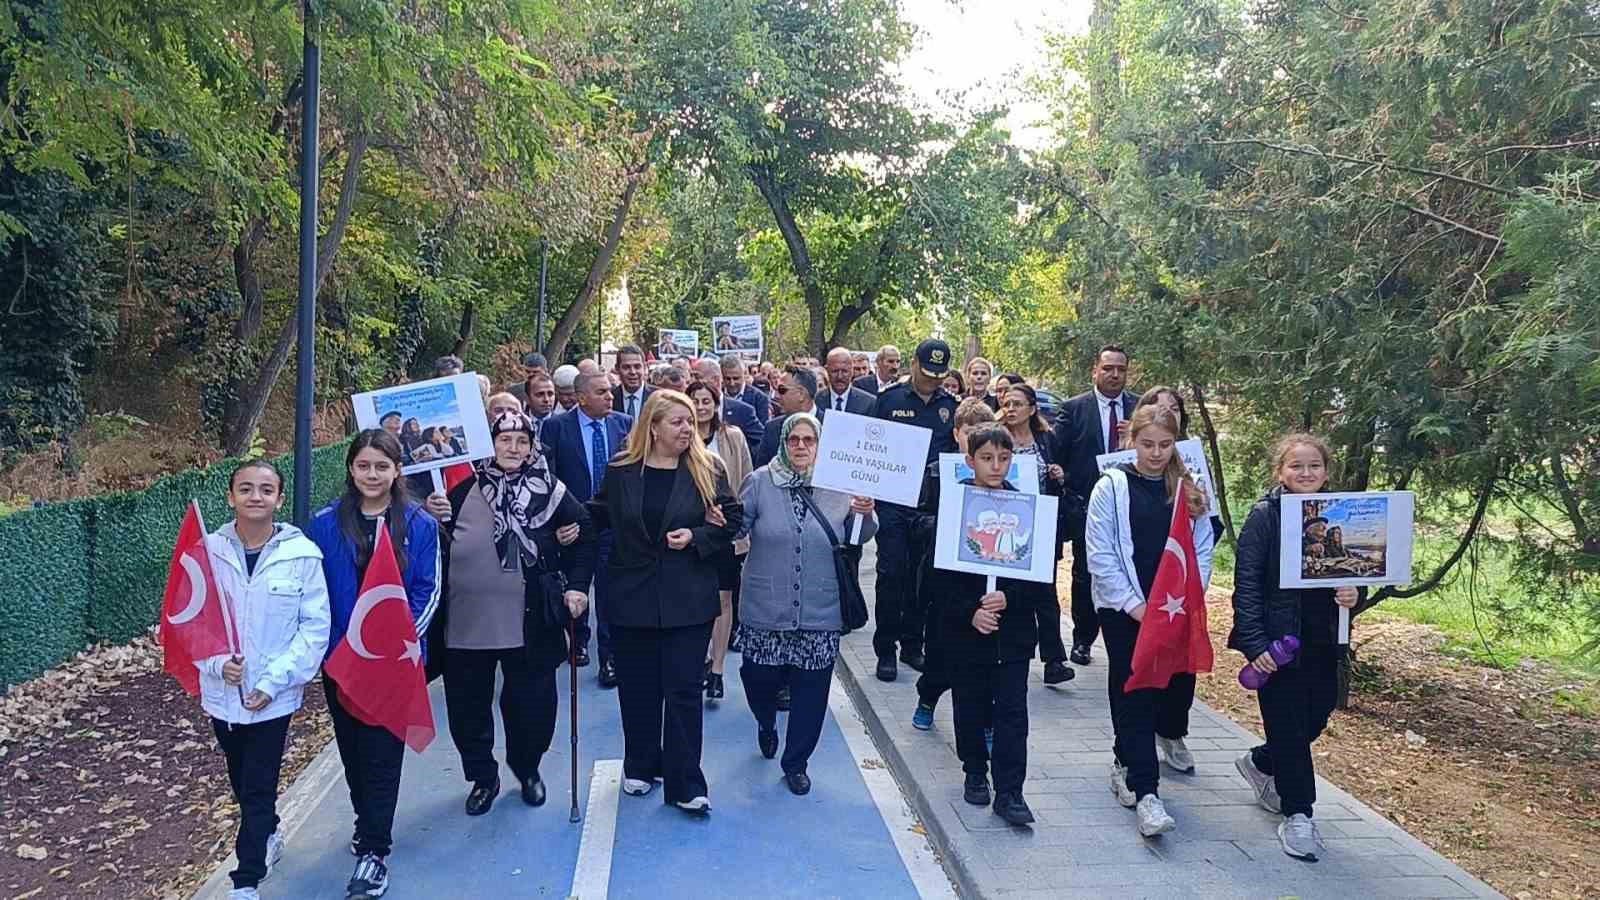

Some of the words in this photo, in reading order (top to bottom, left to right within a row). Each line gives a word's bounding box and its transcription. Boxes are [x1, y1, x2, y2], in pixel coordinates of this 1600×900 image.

[856, 440, 861, 449] 1
[830, 450, 863, 464] DÜNYA
[865, 458, 907, 474] YAŞLILAR
[850, 469, 880, 483] GÜNÜ
